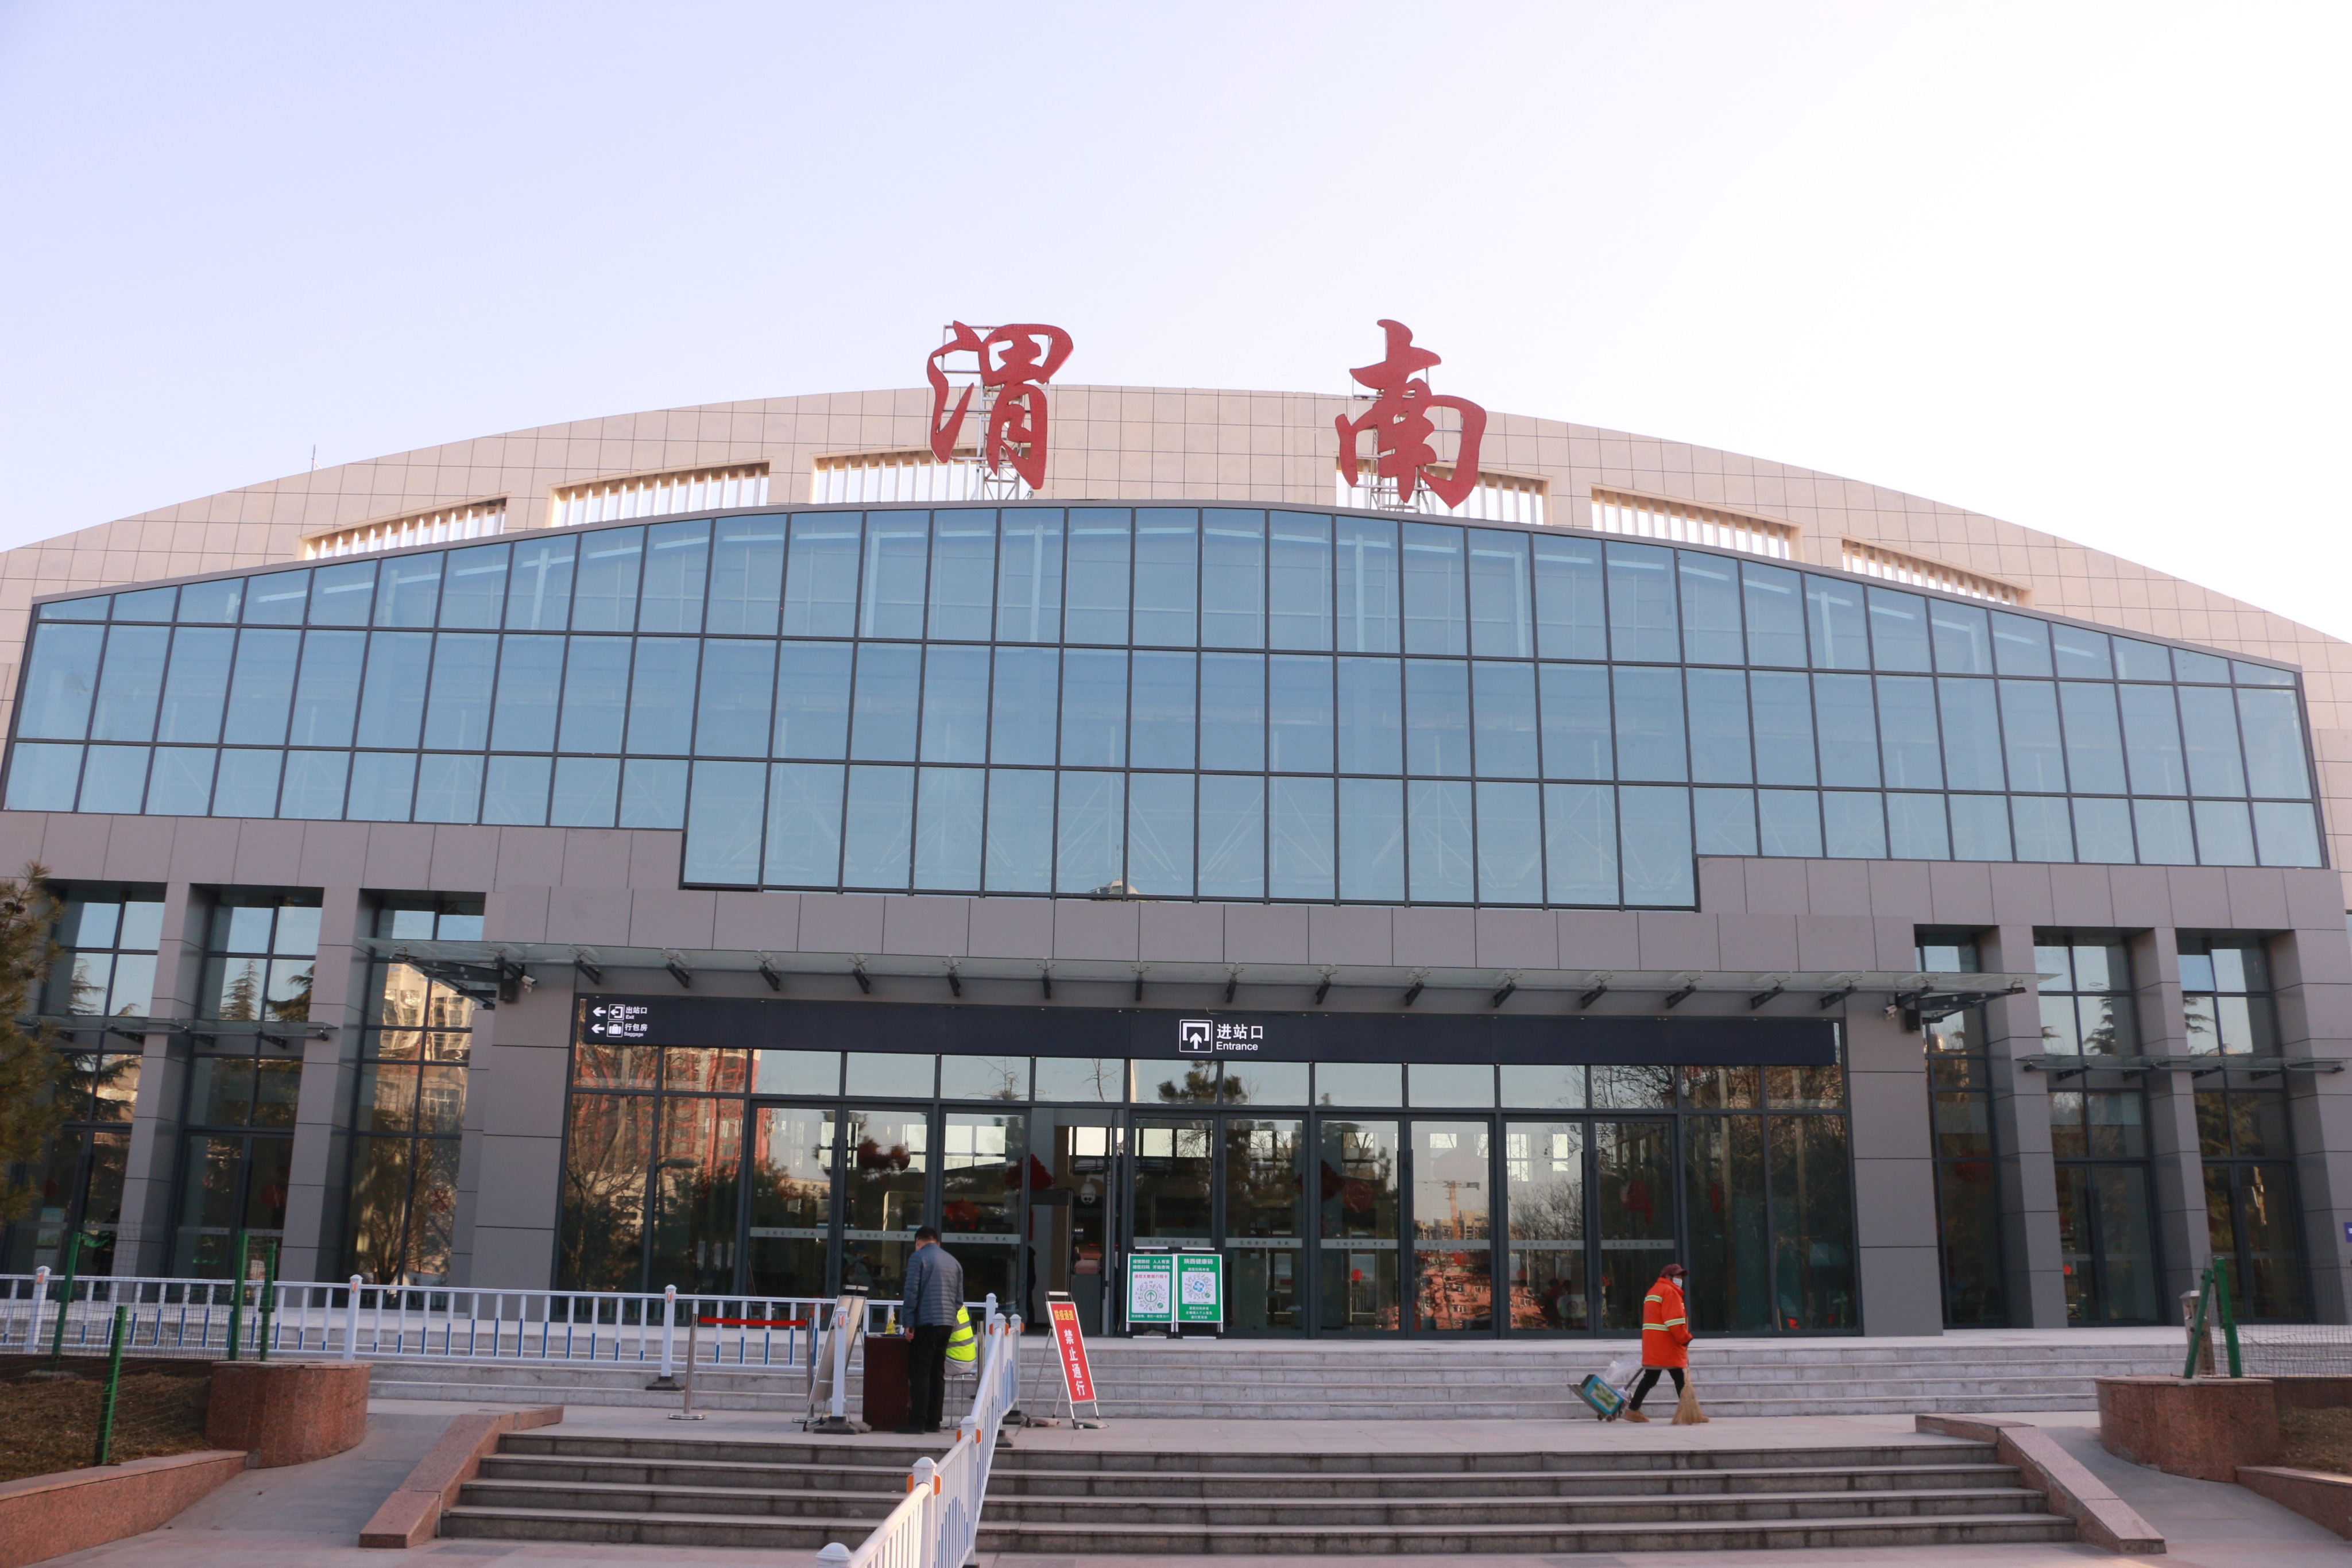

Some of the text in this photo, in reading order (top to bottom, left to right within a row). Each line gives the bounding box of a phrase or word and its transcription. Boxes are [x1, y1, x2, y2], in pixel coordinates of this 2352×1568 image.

[927, 319, 1487, 510] 渭南
[625, 1006, 648, 1015] 出站口
[624, 1023, 648, 1032] 行包房
[1217, 1023, 1263, 1040] 进站口
[1216, 1041, 1258, 1050] Entrance
[1054, 1310, 1074, 1321] 防疫通道
[1063, 1329, 1085, 1396] 禁止通行
